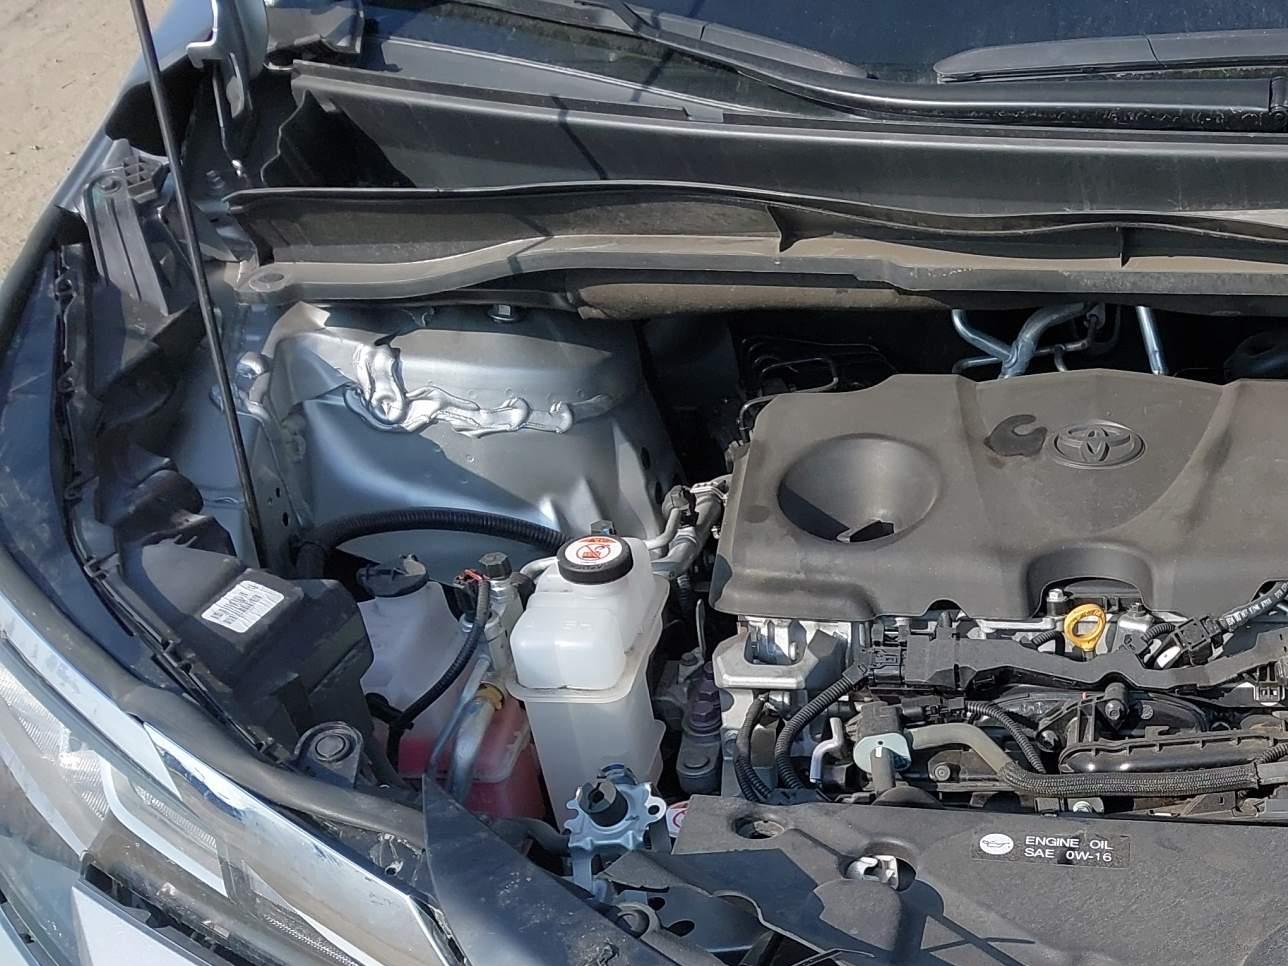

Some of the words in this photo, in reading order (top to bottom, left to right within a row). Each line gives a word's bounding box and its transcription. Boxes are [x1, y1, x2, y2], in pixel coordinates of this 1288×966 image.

[1025, 835, 1080, 848] ENGINE
[1089, 839, 1114, 850] OIL
[1024, 847, 1055, 858] SAE
[1065, 850, 1112, 862] 0W-16
